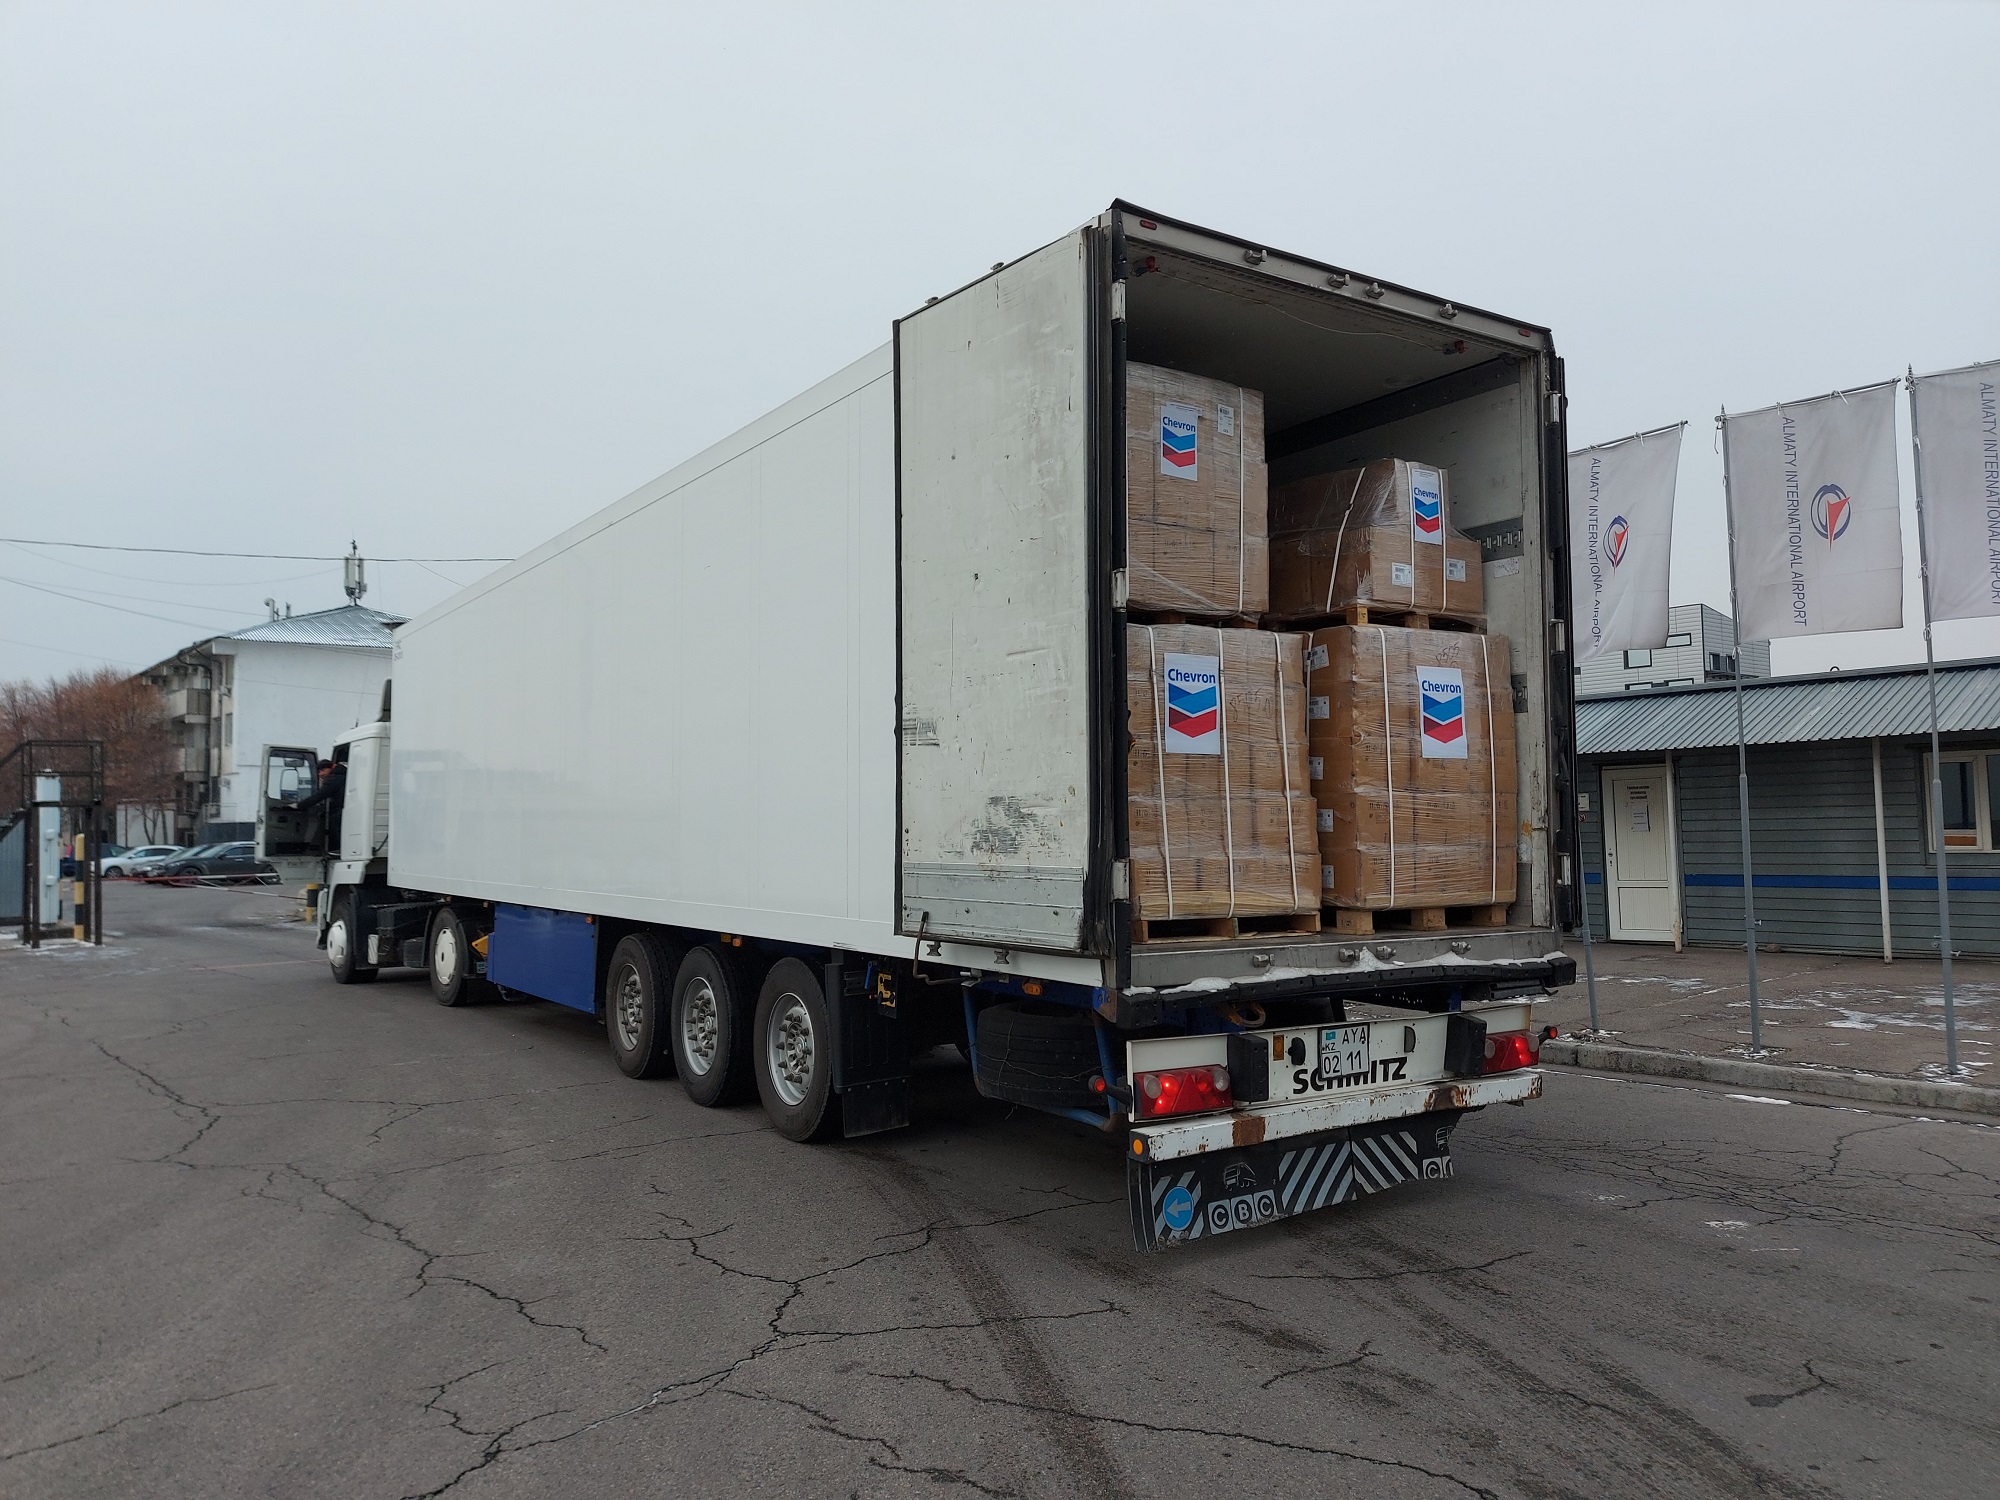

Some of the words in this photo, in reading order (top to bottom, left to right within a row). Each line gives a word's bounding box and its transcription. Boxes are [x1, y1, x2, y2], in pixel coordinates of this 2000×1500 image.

[1163, 416, 1196, 432] Chevron
[1980, 382, 1997, 436] ALMATY
[1782, 416, 1797, 467] ALMATY
[1414, 487, 1438, 499] Chevron
[1588, 457, 1601, 503] ALMATY
[1983, 439, 2000, 545] INTERNATIONAL
[1785, 470, 1803, 568] INTERNATIONAL
[1588, 505, 1603, 597] INTERNATIONAL
[1790, 571, 1807, 626] AIRPORT
[1168, 669, 1216, 683] Chevron
[1421, 680, 1462, 694] Chevron
[1323, 1055, 1340, 1075] 02
[1346, 1050, 1362, 1071] 11
[1325, 1042, 1336, 1051] KZ
